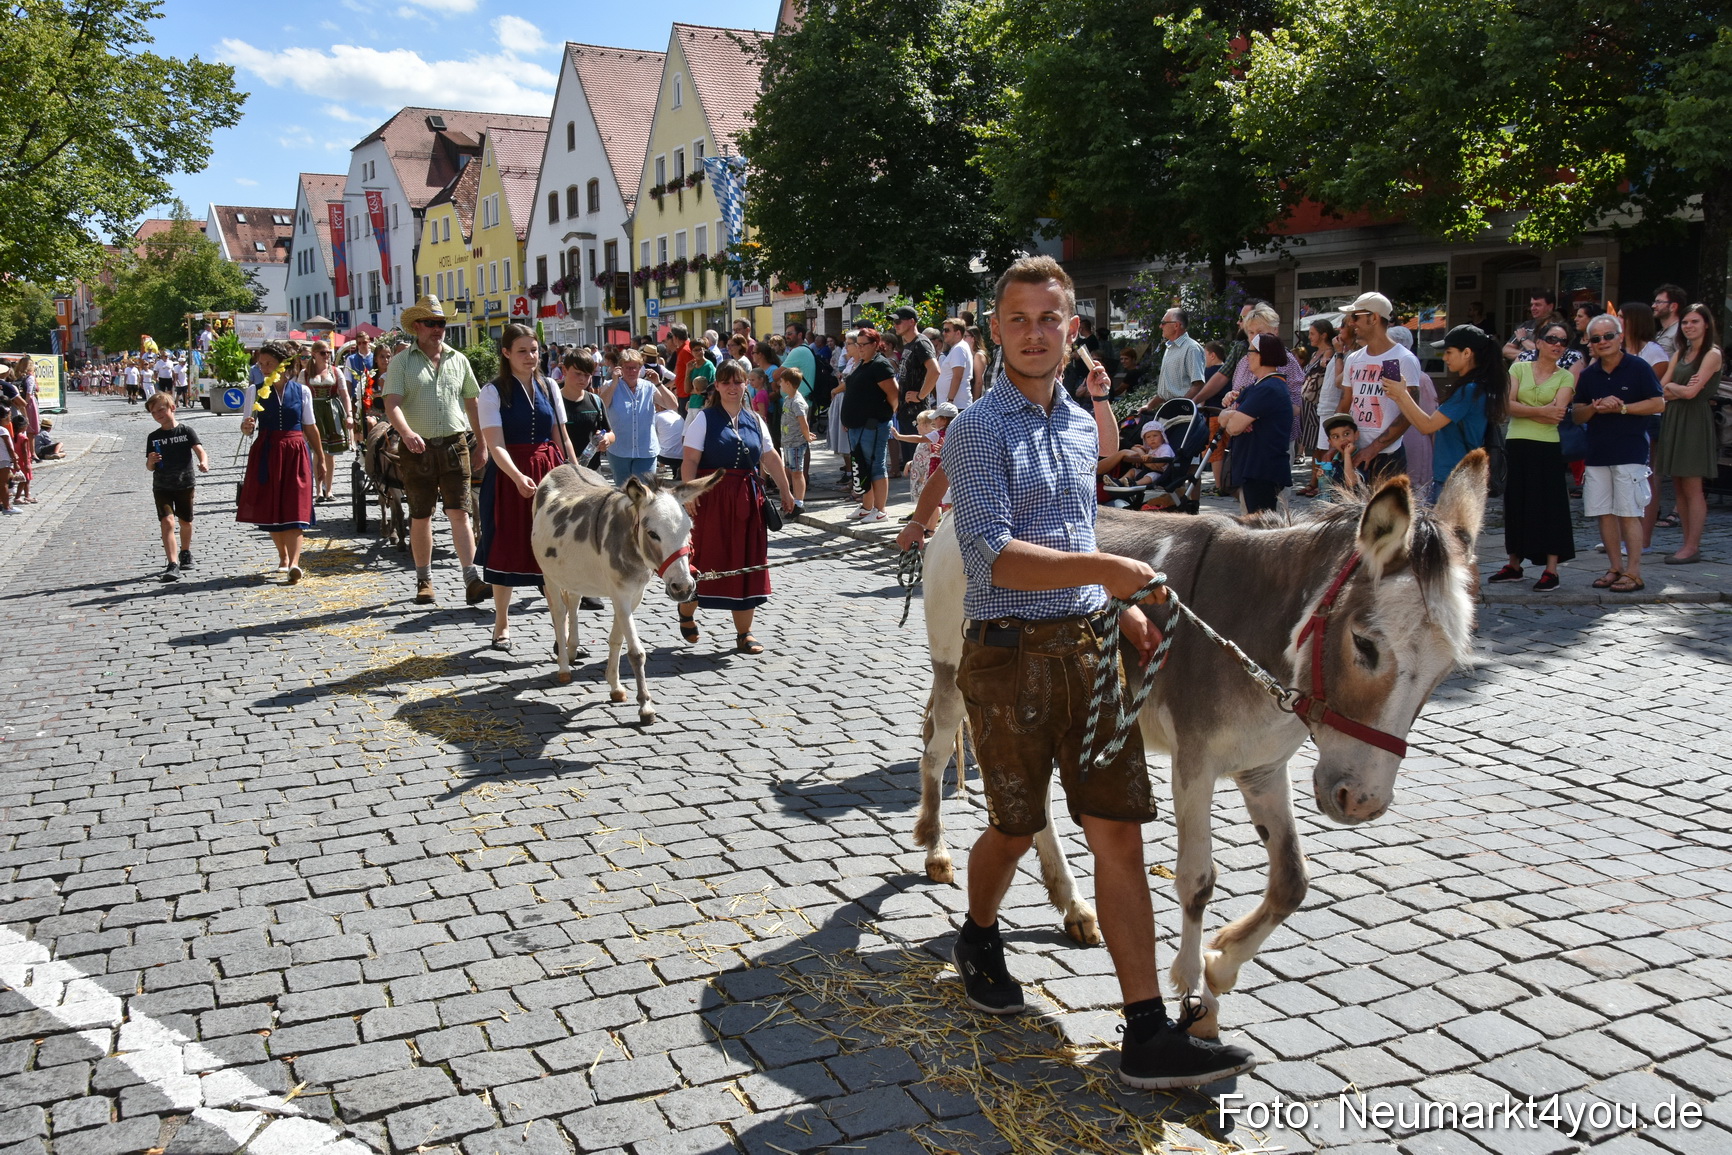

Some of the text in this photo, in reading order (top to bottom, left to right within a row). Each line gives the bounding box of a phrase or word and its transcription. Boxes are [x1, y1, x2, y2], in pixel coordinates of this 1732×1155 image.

[367, 193, 381, 215] K&L
[333, 206, 343, 229] K&L
[438, 255, 452, 269] HOTEL
[1358, 411, 1377, 423] CO.
[170, 434, 189, 444] YORK
